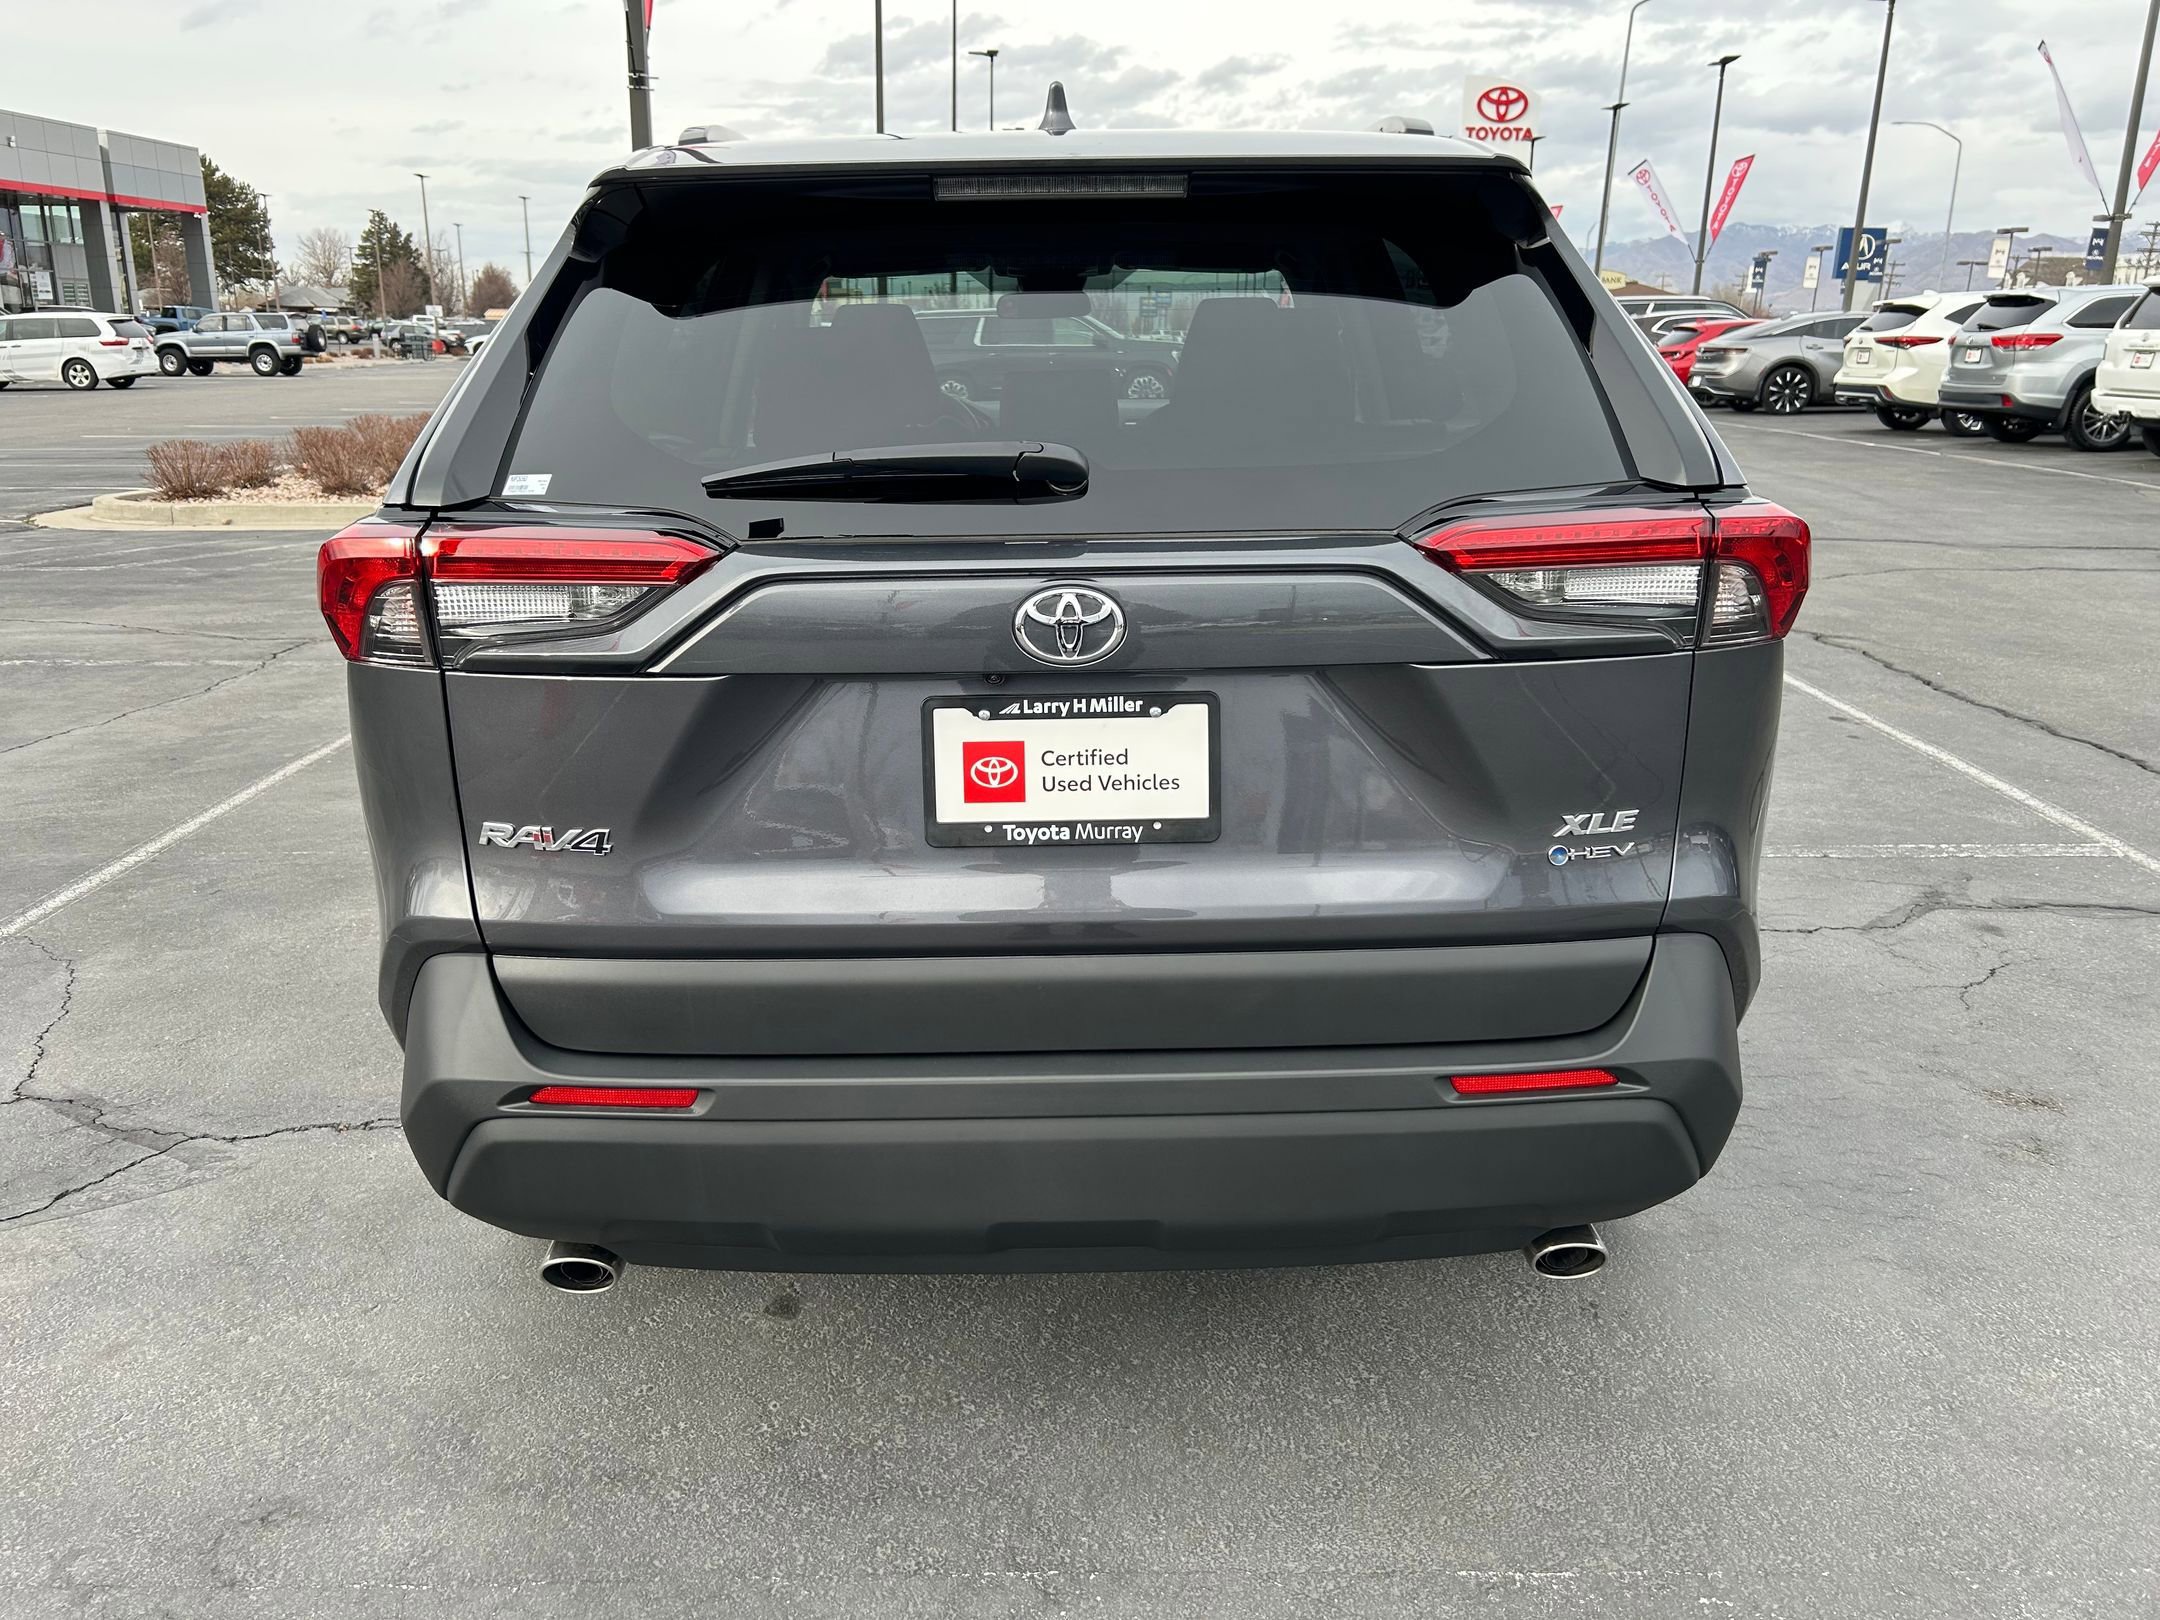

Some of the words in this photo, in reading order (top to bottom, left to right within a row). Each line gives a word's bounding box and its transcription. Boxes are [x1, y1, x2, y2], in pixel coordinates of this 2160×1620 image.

[1465, 126, 1533, 141] TOYOTA
[1646, 184, 1676, 233] TOYOTA
[1711, 177, 1740, 230] TOYOTA
[1023, 699, 1071, 717] Larry
[1073, 698, 1087, 713] H
[1089, 695, 1144, 713] Miller
[1041, 748, 1128, 766] Certified
[1042, 774, 1092, 792] Used
[1098, 773, 1180, 791] Vehicles
[1002, 824, 1071, 845] Toyota
[1074, 822, 1144, 843] Murray
[1552, 809, 1640, 838] XLE
[478, 821, 613, 856] RAV4
